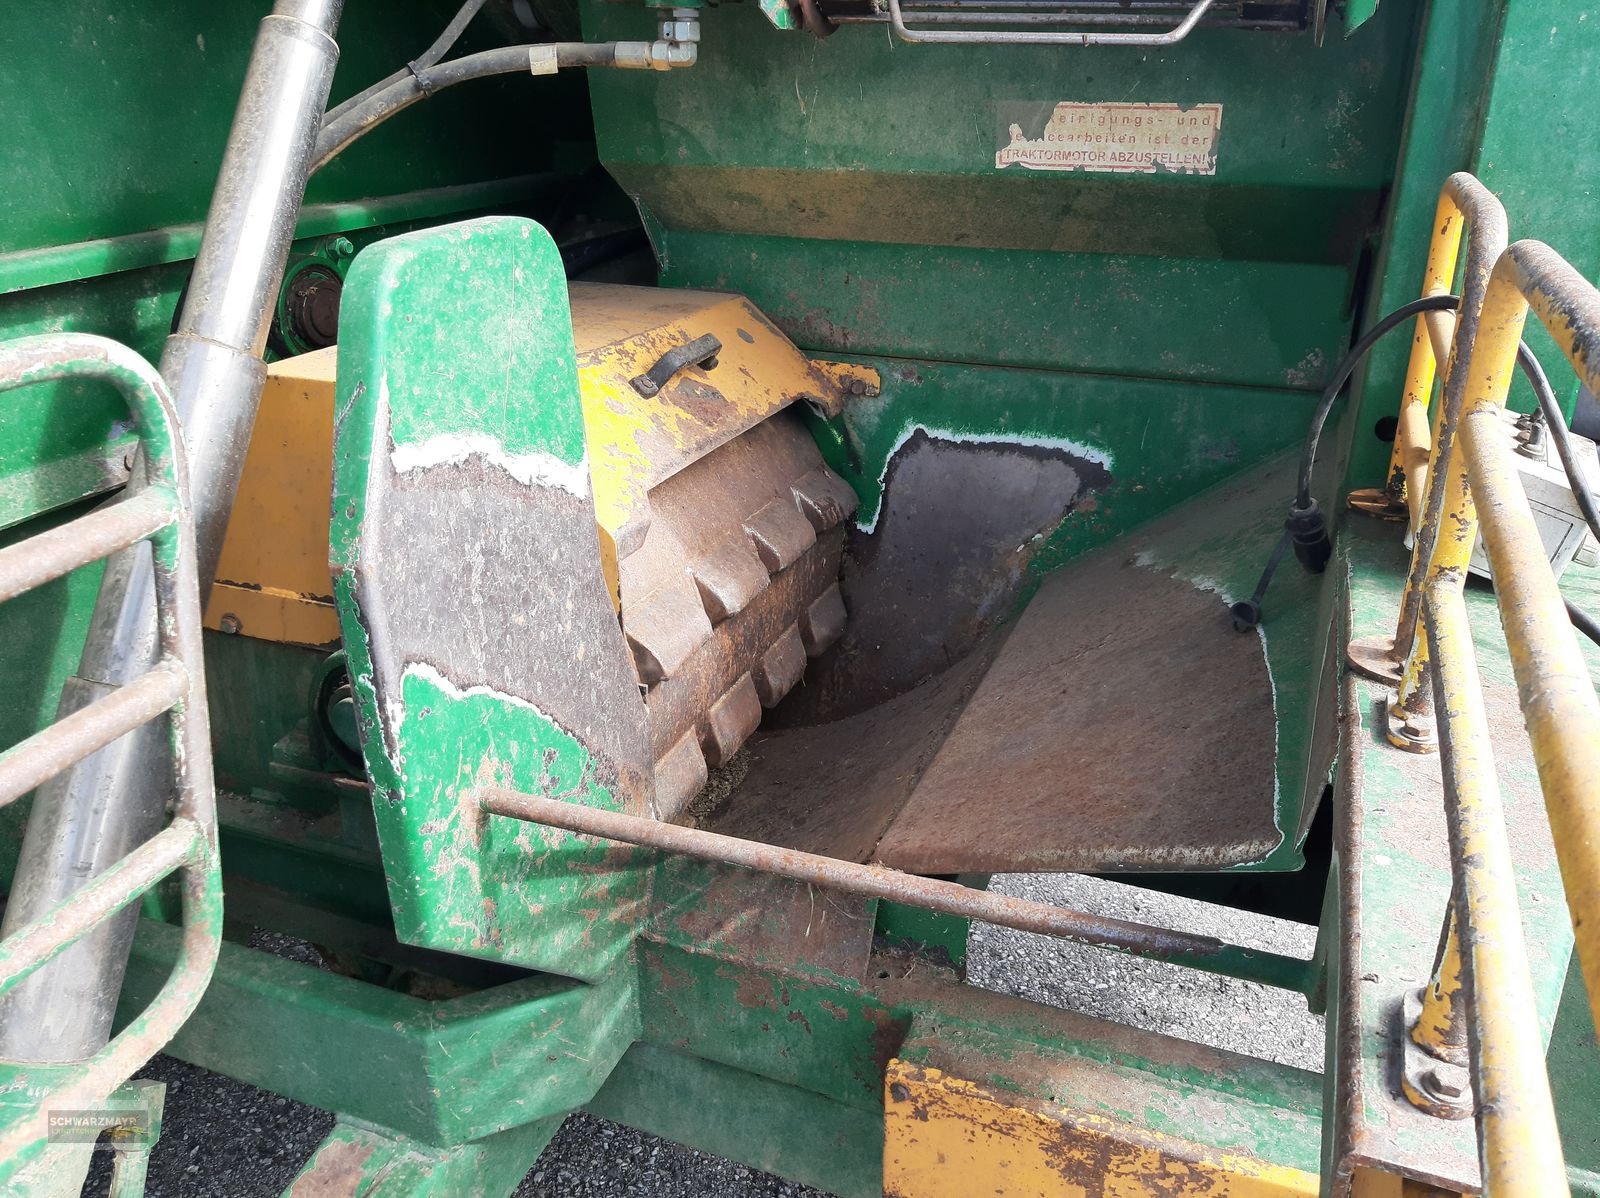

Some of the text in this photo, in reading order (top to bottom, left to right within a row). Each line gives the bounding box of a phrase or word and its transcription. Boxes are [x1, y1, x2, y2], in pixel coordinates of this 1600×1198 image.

[1177, 115, 1211, 126] und
[1148, 133, 1169, 145] ist
[1181, 135, 1209, 146] der
[1004, 149, 1206, 165] TRAKTORMOTOR ABZUSTELLEN!
